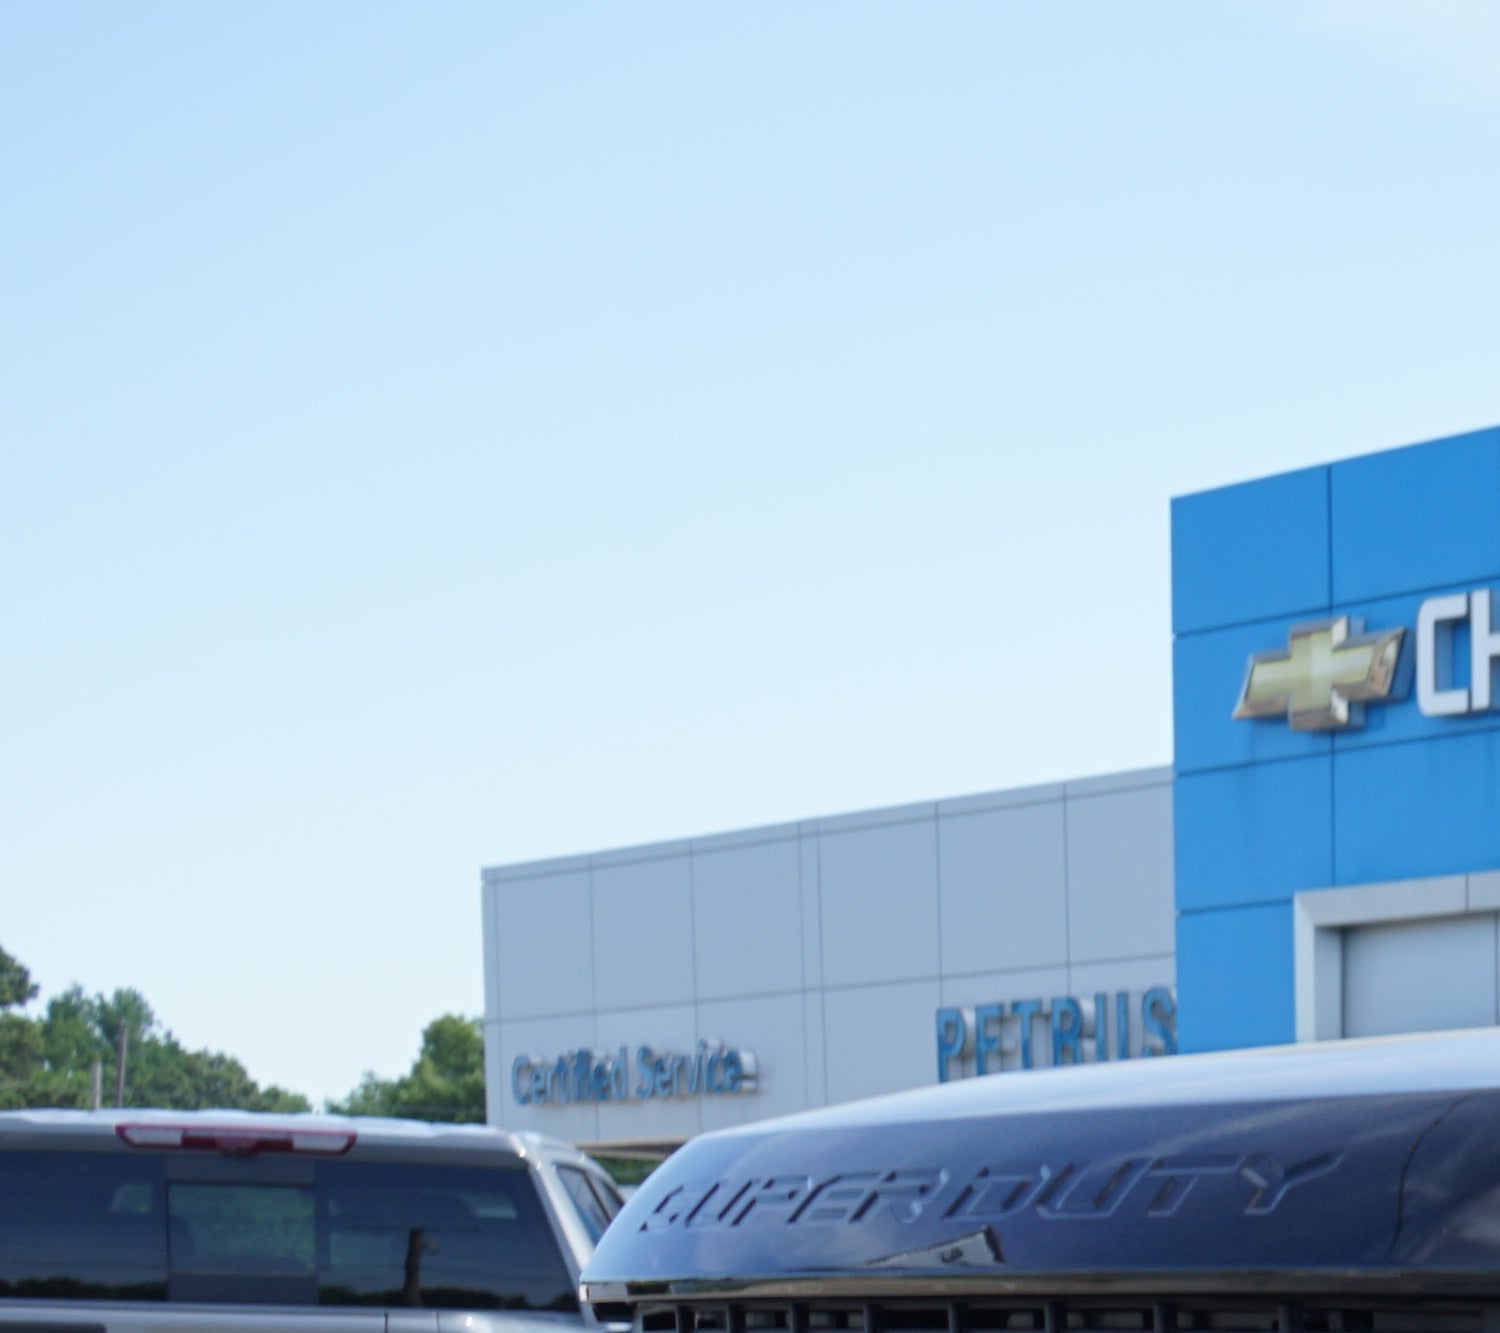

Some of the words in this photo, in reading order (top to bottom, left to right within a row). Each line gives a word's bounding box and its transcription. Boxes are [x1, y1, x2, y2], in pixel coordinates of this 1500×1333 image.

[511, 1043, 628, 1107] Certified
[635, 1036, 748, 1099] Service
[639, 1167, 948, 1233] SUPER
[942, 1152, 1345, 1219] DUTY
